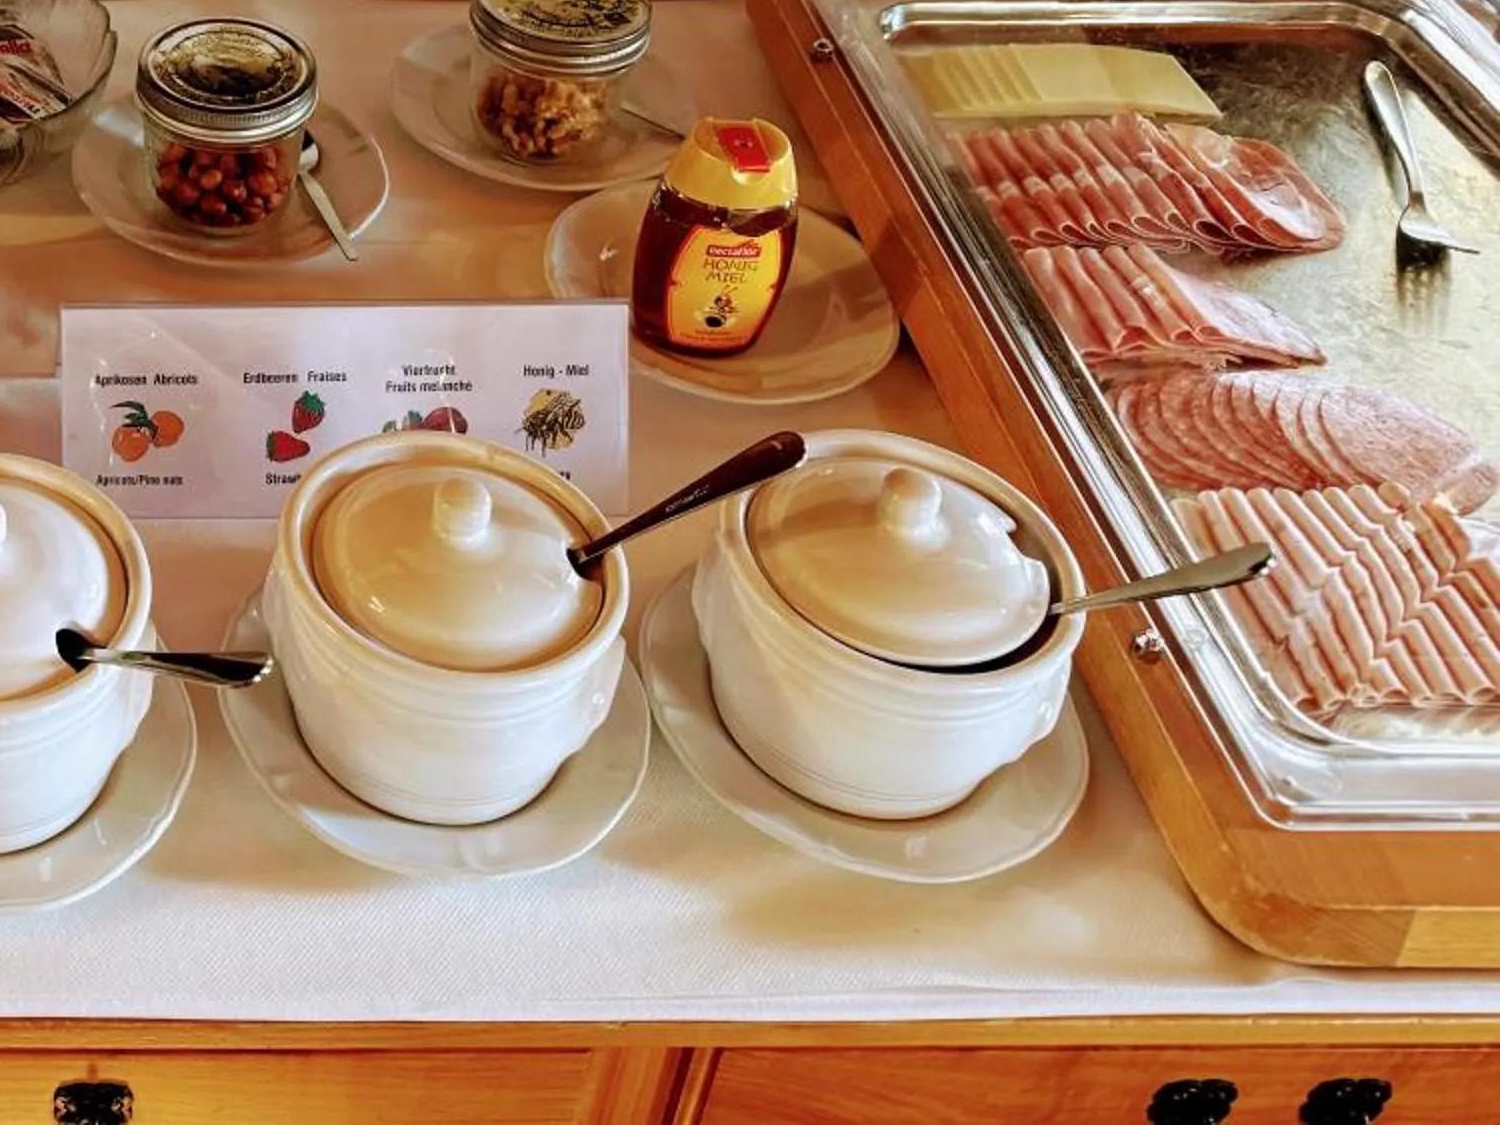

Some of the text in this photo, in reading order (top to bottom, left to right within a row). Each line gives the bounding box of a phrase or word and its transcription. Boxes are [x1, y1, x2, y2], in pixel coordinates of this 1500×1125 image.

[243, 370, 348, 384] Erdbeeren Fraises
[523, 365, 555, 378] Honig
[566, 365, 590, 375] Miel
[95, 373, 199, 387] Aprikosen Abricots
[385, 380, 417, 392] Fruits
